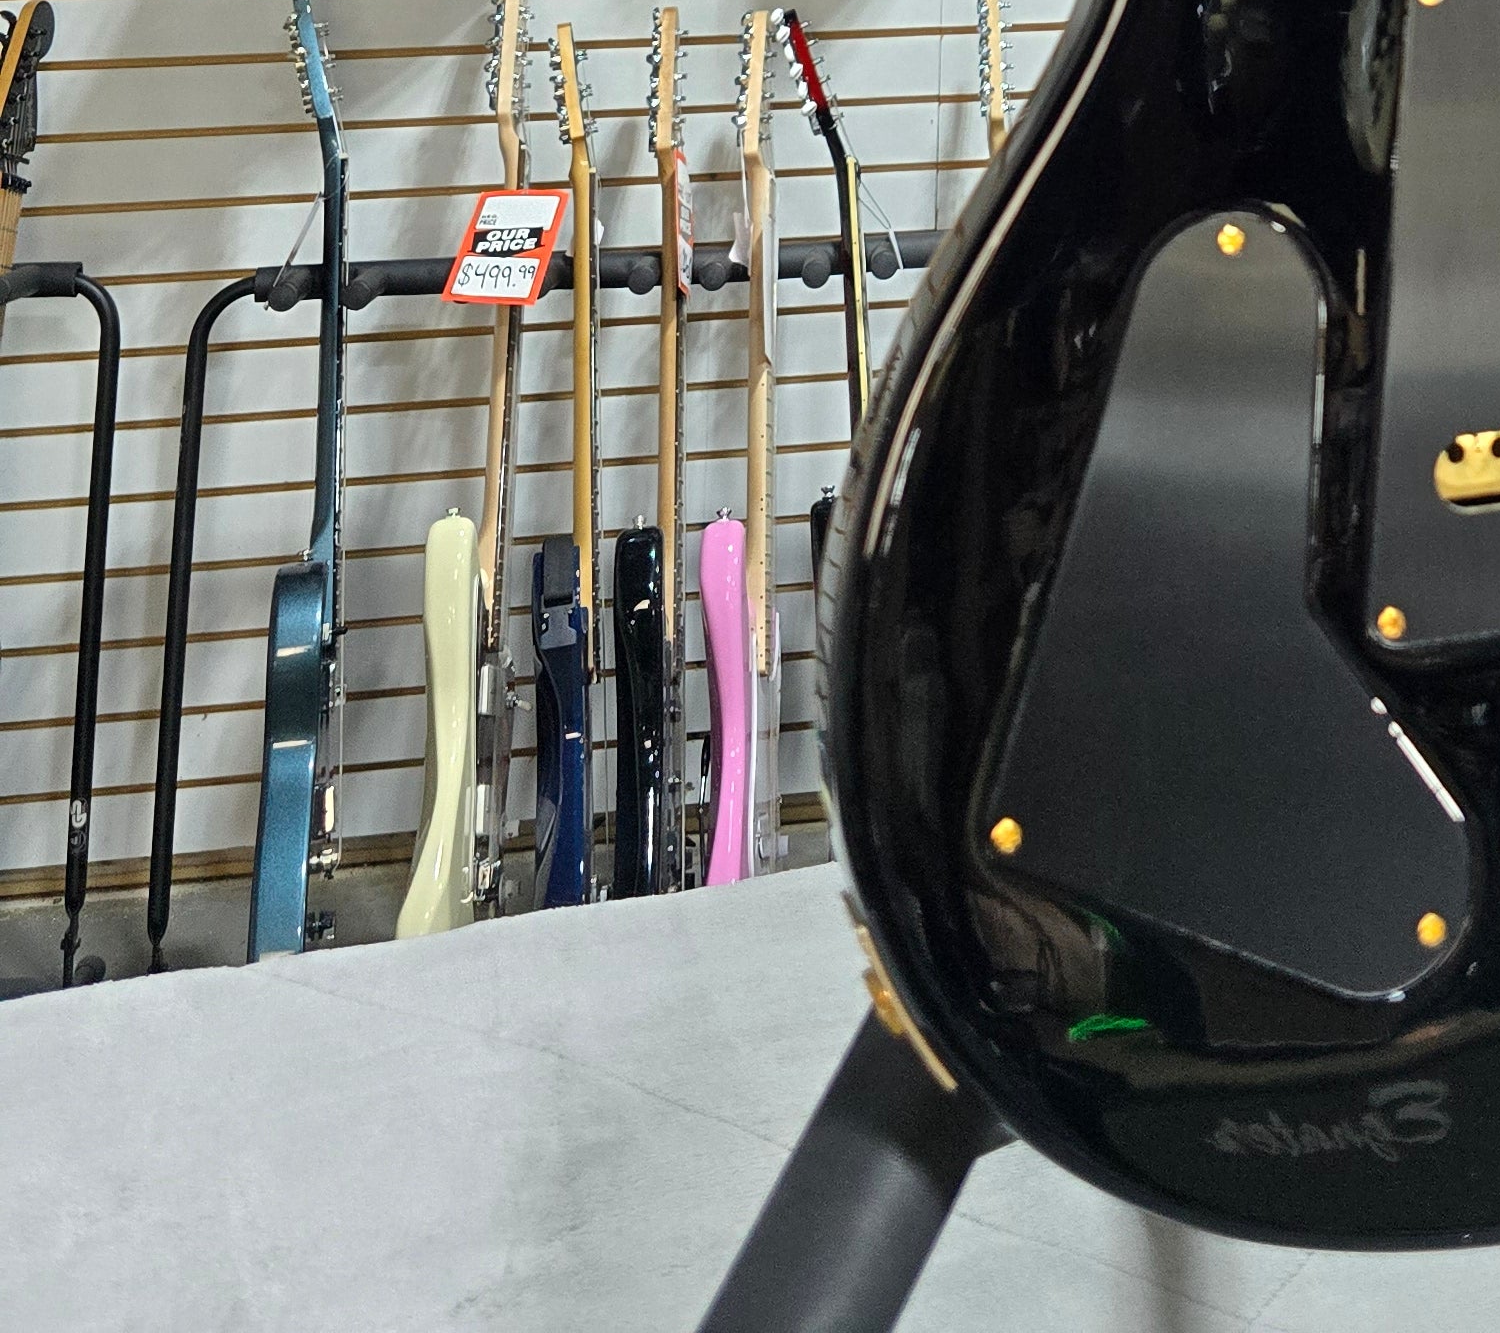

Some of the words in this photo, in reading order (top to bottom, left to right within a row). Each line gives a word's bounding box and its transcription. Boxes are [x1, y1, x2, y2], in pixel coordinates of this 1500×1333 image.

[486, 228, 530, 242] OUR
[475, 237, 538, 253] PRICE
[458, 263, 536, 290] $499.99
